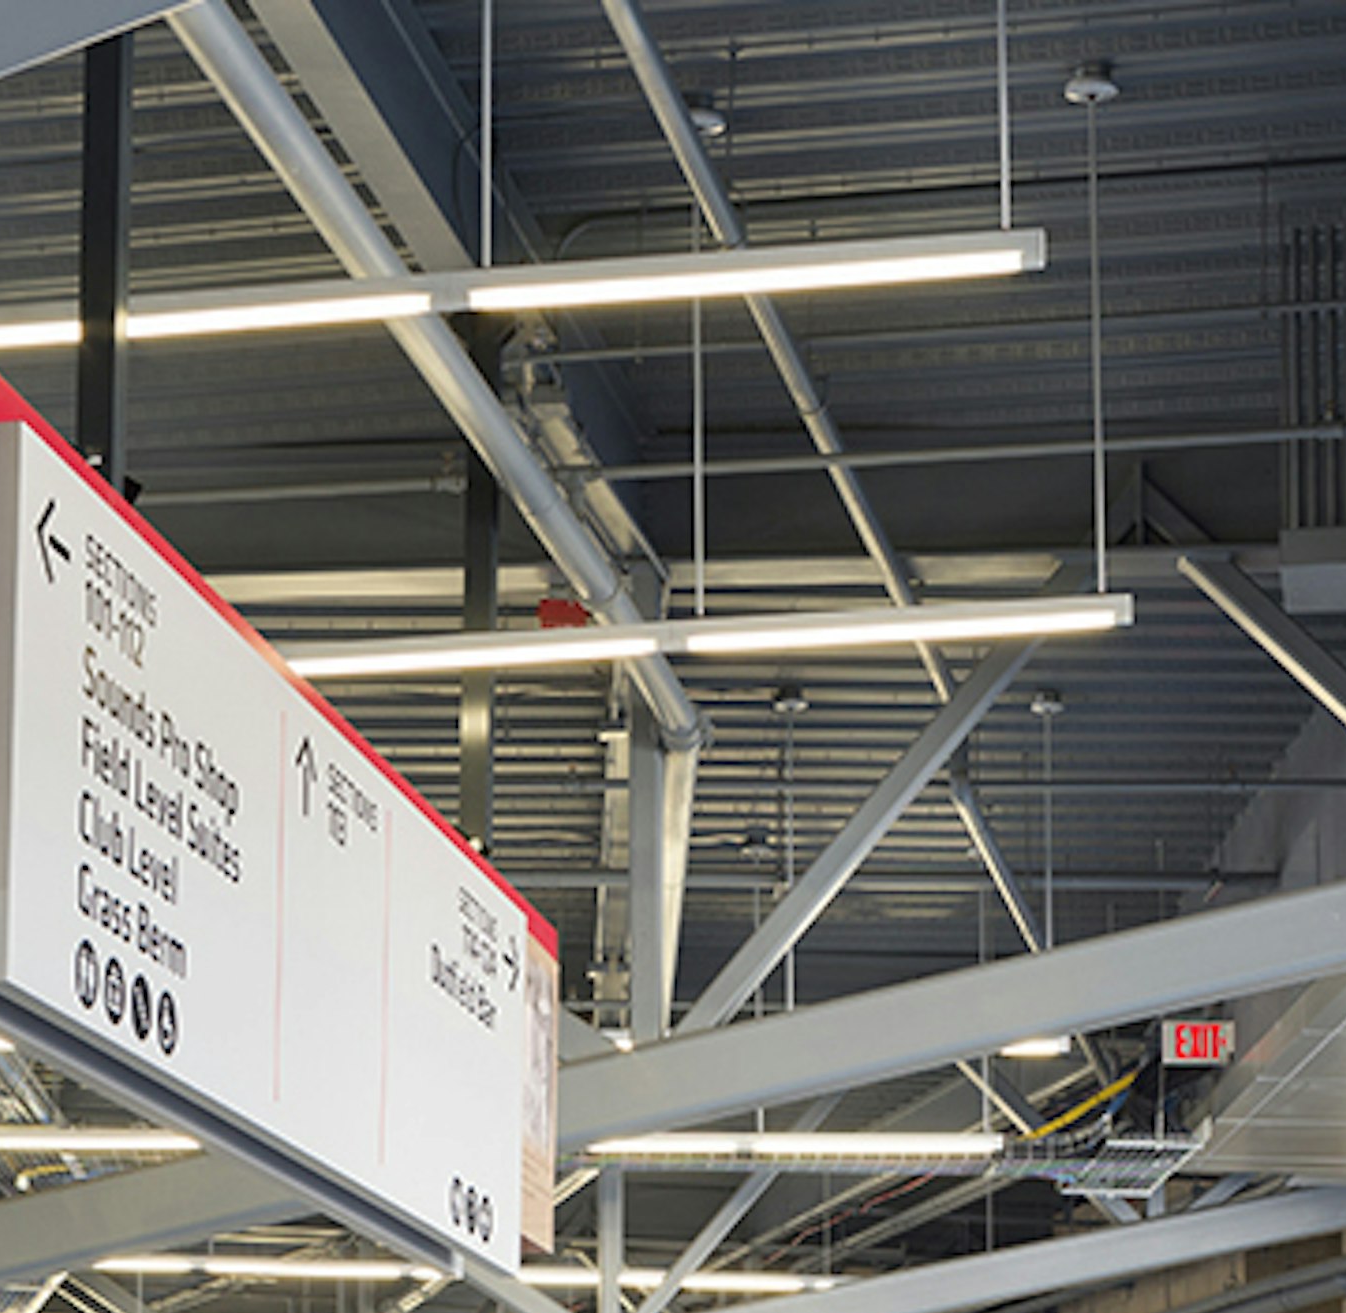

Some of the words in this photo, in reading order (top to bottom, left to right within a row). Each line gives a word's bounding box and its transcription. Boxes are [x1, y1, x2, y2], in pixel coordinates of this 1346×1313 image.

[86, 534, 157, 628] SECTIONS
[82, 646, 154, 749] Sounds
[160, 710, 191, 778] Pro
[194, 741, 240, 827] Shop
[79, 790, 125, 867] Club
[127, 827, 178, 906] Level
[81, 715, 131, 798] Field
[134, 758, 184, 842] Level
[187, 802, 241, 884] Suites
[78, 862, 133, 944] Grass
[137, 901, 188, 980] Berm
[1175, 1023, 1221, 1059] EXIT
